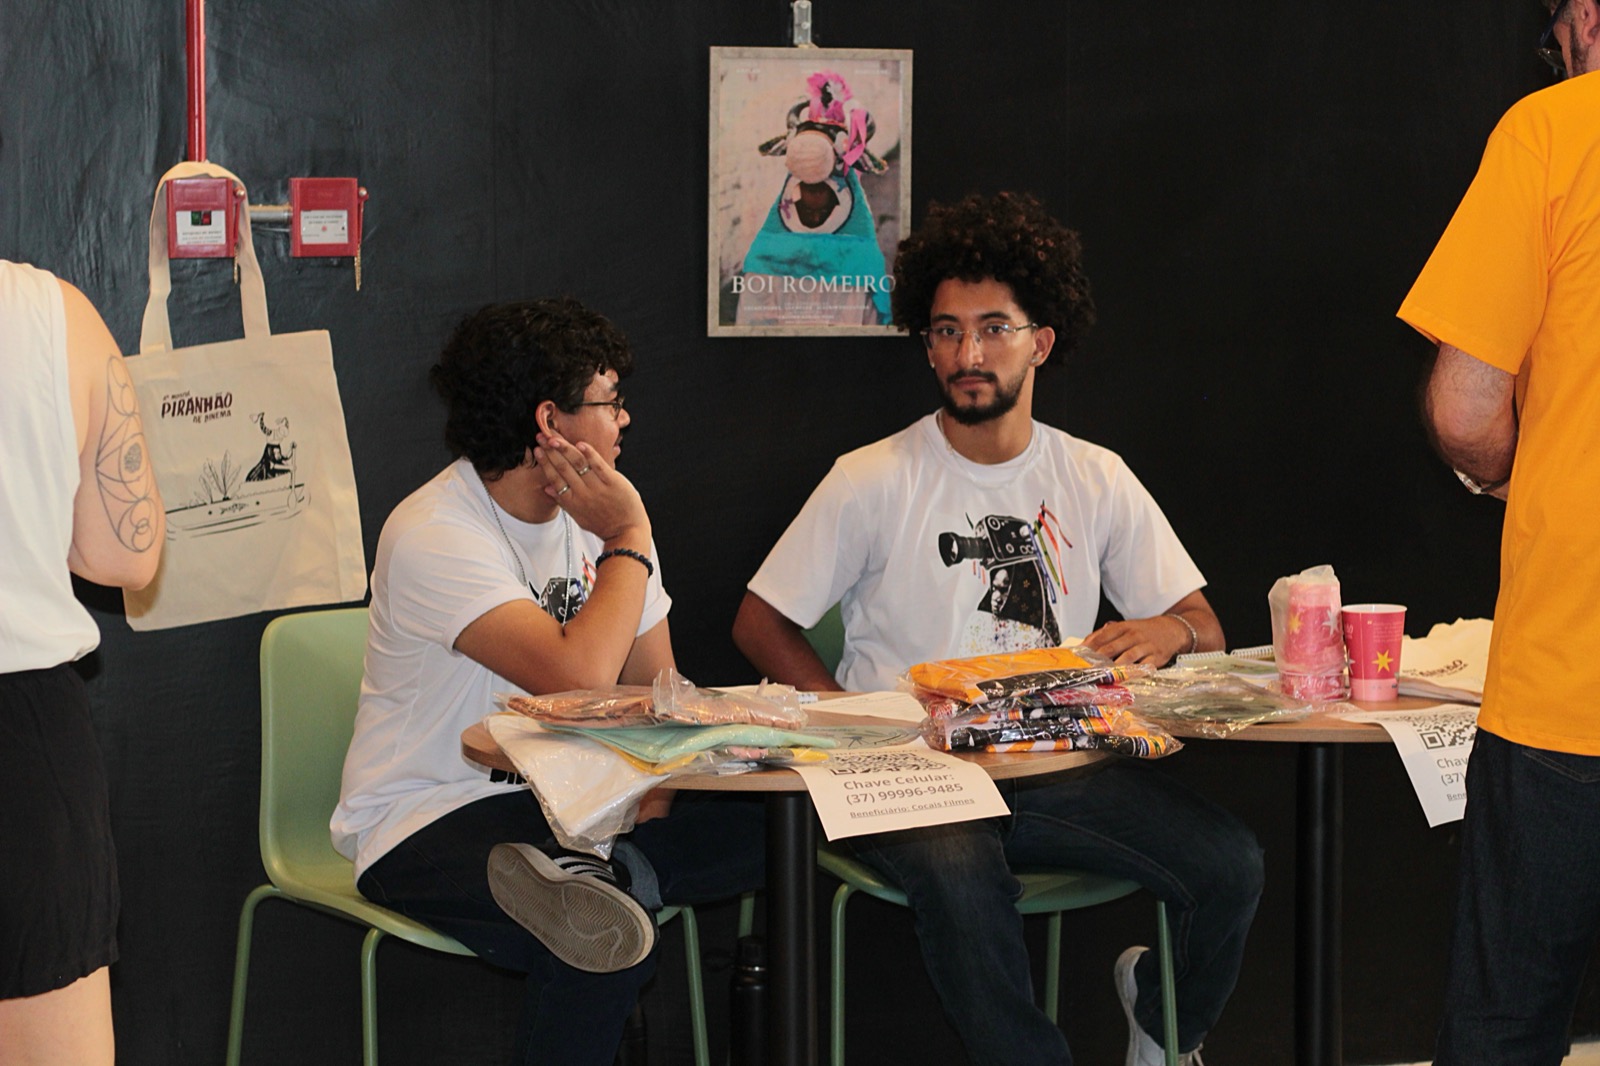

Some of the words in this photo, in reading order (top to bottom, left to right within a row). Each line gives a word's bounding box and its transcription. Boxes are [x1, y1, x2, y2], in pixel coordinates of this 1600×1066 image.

[731, 275, 774, 294] BOI
[782, 275, 897, 294] ROMEIRO
[161, 392, 232, 419] PIRANHÃO
[1436, 757, 1469, 769] Chav
[843, 779, 892, 791] Chave
[894, 772, 955, 785] Celular:
[846, 791, 876, 806] (37)
[878, 783, 964, 802] 99996-9485
[850, 806, 910, 819] Beneficiário:
[911, 802, 942, 812] Cocais
[944, 798, 976, 808] Filmes
